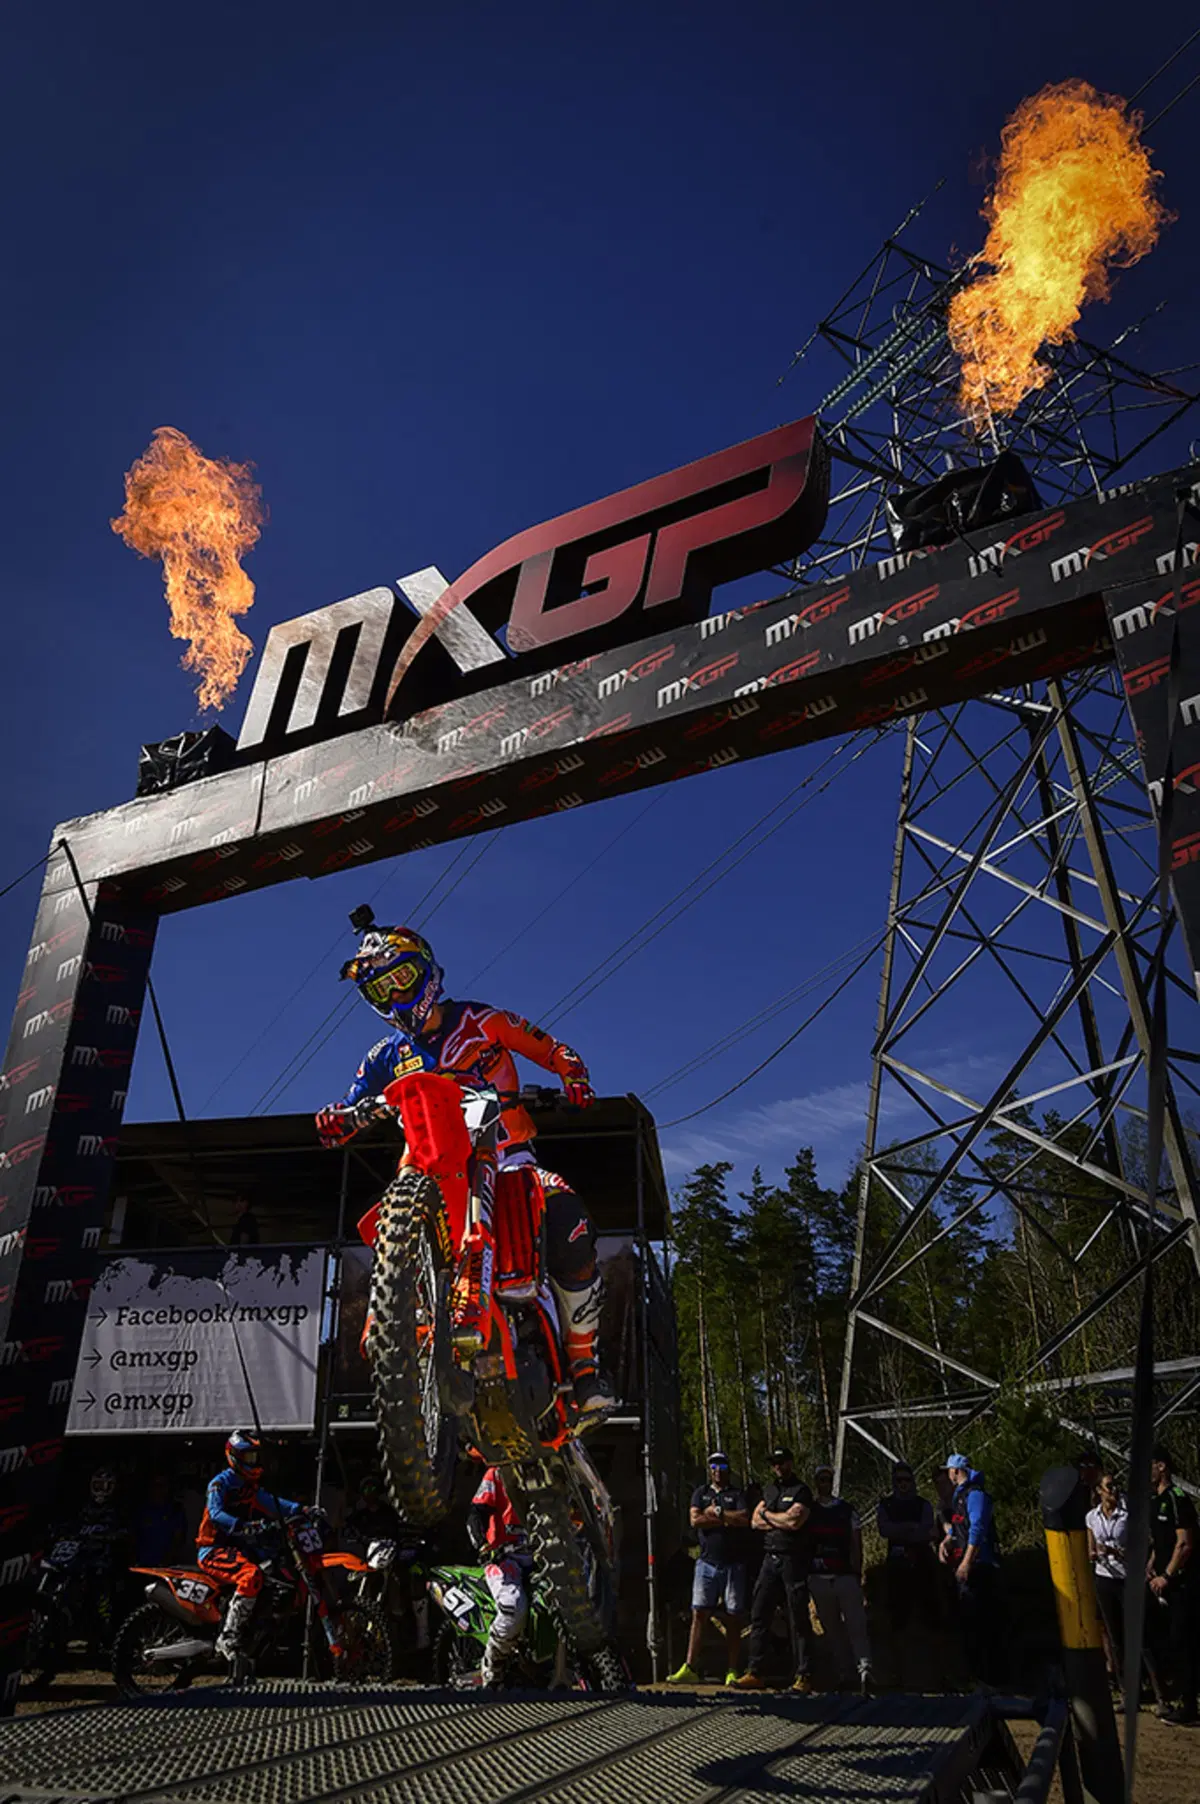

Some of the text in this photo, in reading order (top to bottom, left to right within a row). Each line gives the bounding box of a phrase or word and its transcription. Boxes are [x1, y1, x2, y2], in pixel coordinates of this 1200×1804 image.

[1050, 515, 1154, 583] MXGP
[236, 415, 816, 751] MXGP
[765, 586, 850, 647] MXGP
[848, 584, 939, 646] MXGP
[598, 644, 675, 700] MXGP
[657, 652, 739, 709] MXGP
[115, 1302, 308, 1326] Facebook/mxgp
[110, 1349, 198, 1371] @mxgp
[105, 1391, 193, 1415] @mxgp
[297, 1528, 324, 1553] 33
[176, 1579, 210, 1604] 33
[443, 1586, 475, 1617] 57
